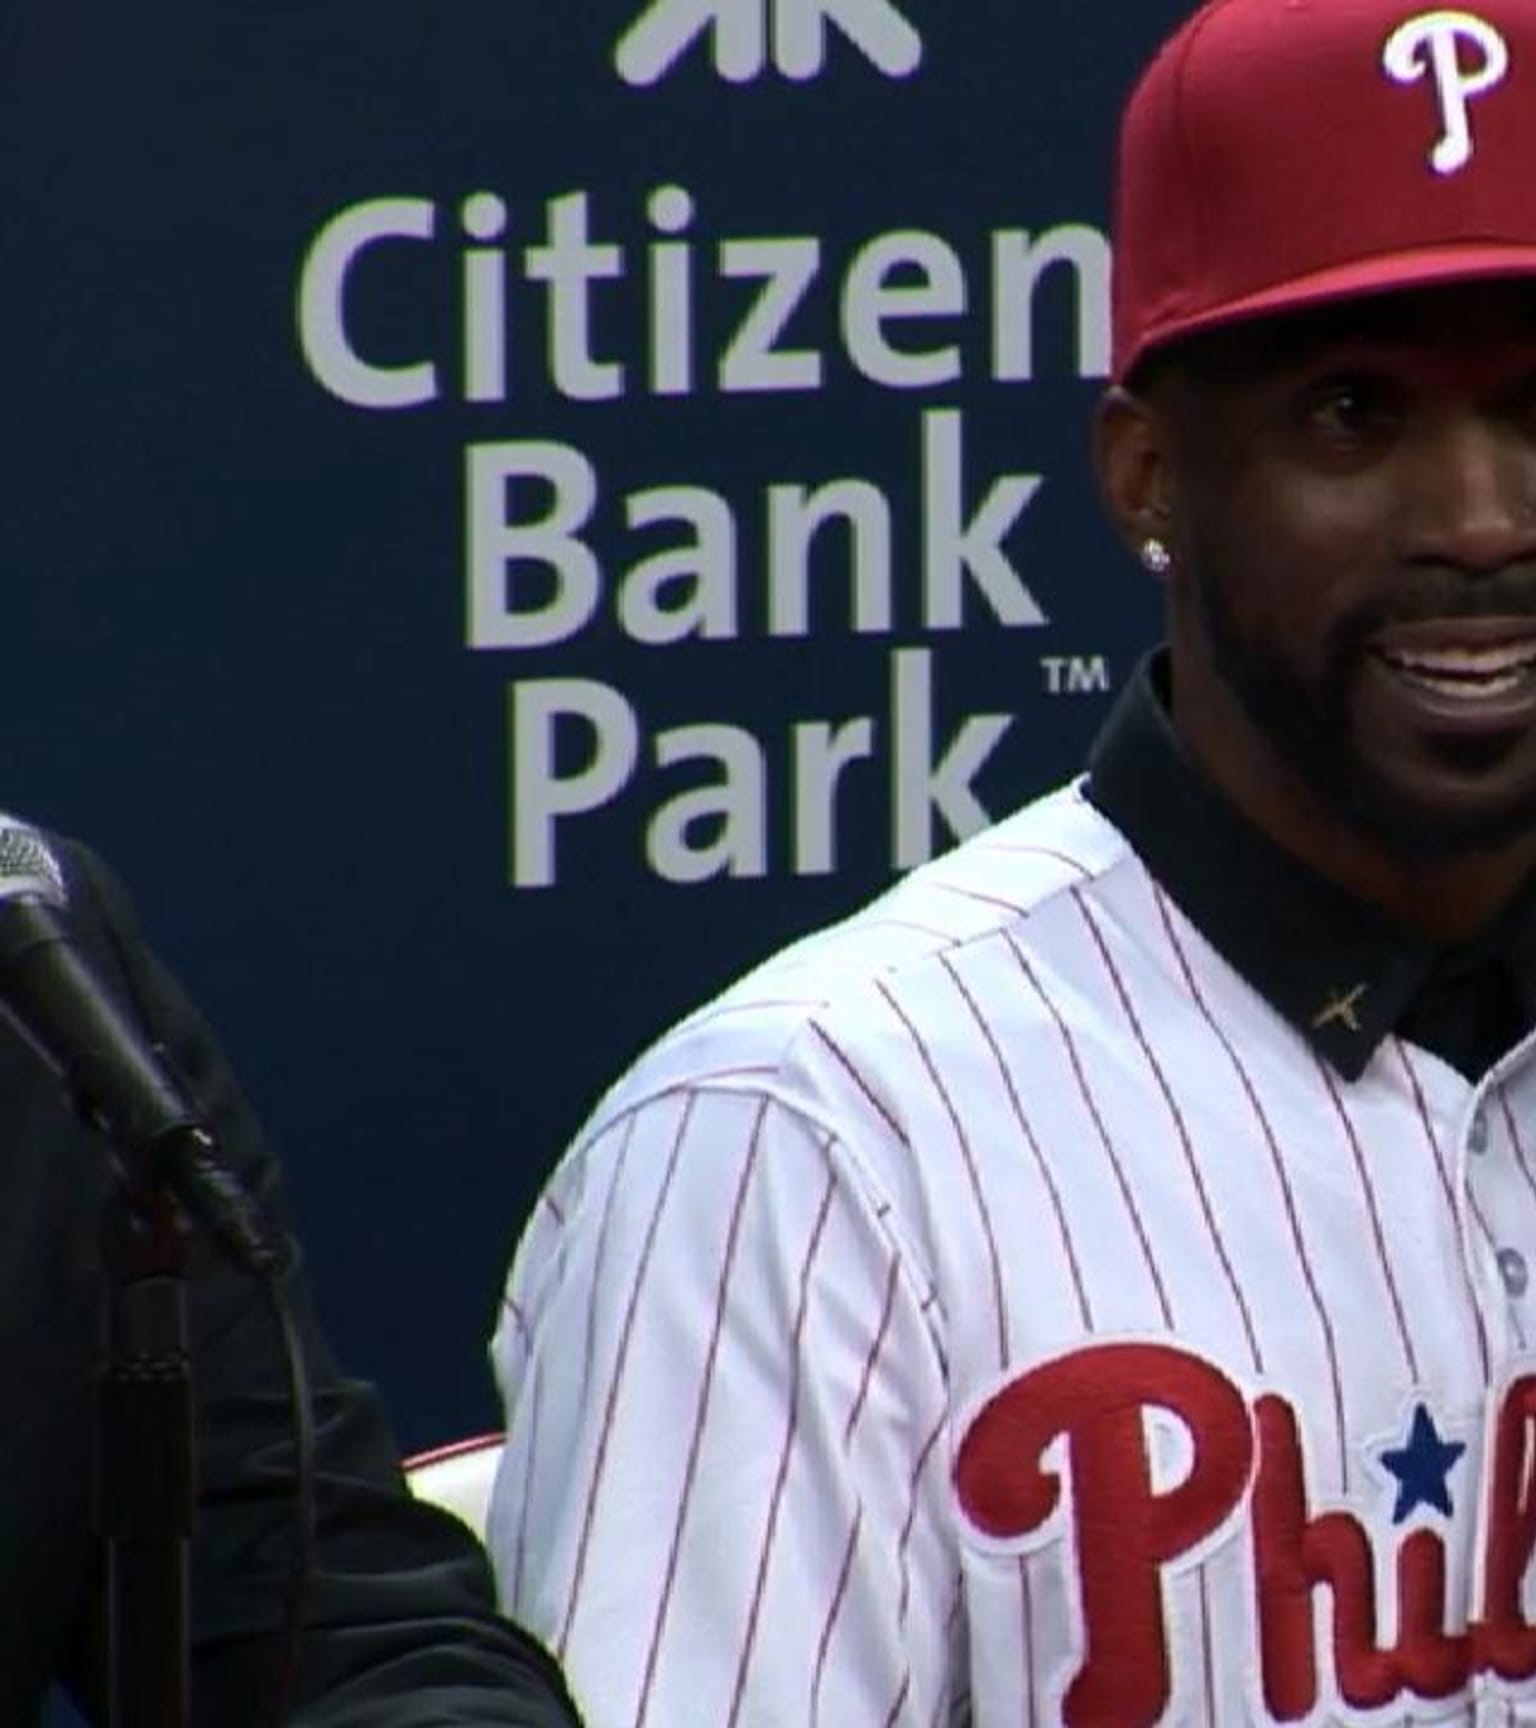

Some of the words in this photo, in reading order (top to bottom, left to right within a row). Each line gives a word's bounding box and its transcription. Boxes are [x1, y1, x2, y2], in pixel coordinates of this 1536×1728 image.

[1383, 10, 1508, 175] P
[464, 409, 1050, 649] Bank
[511, 648, 1015, 886] Park
[1040, 656, 1109, 693] TM
